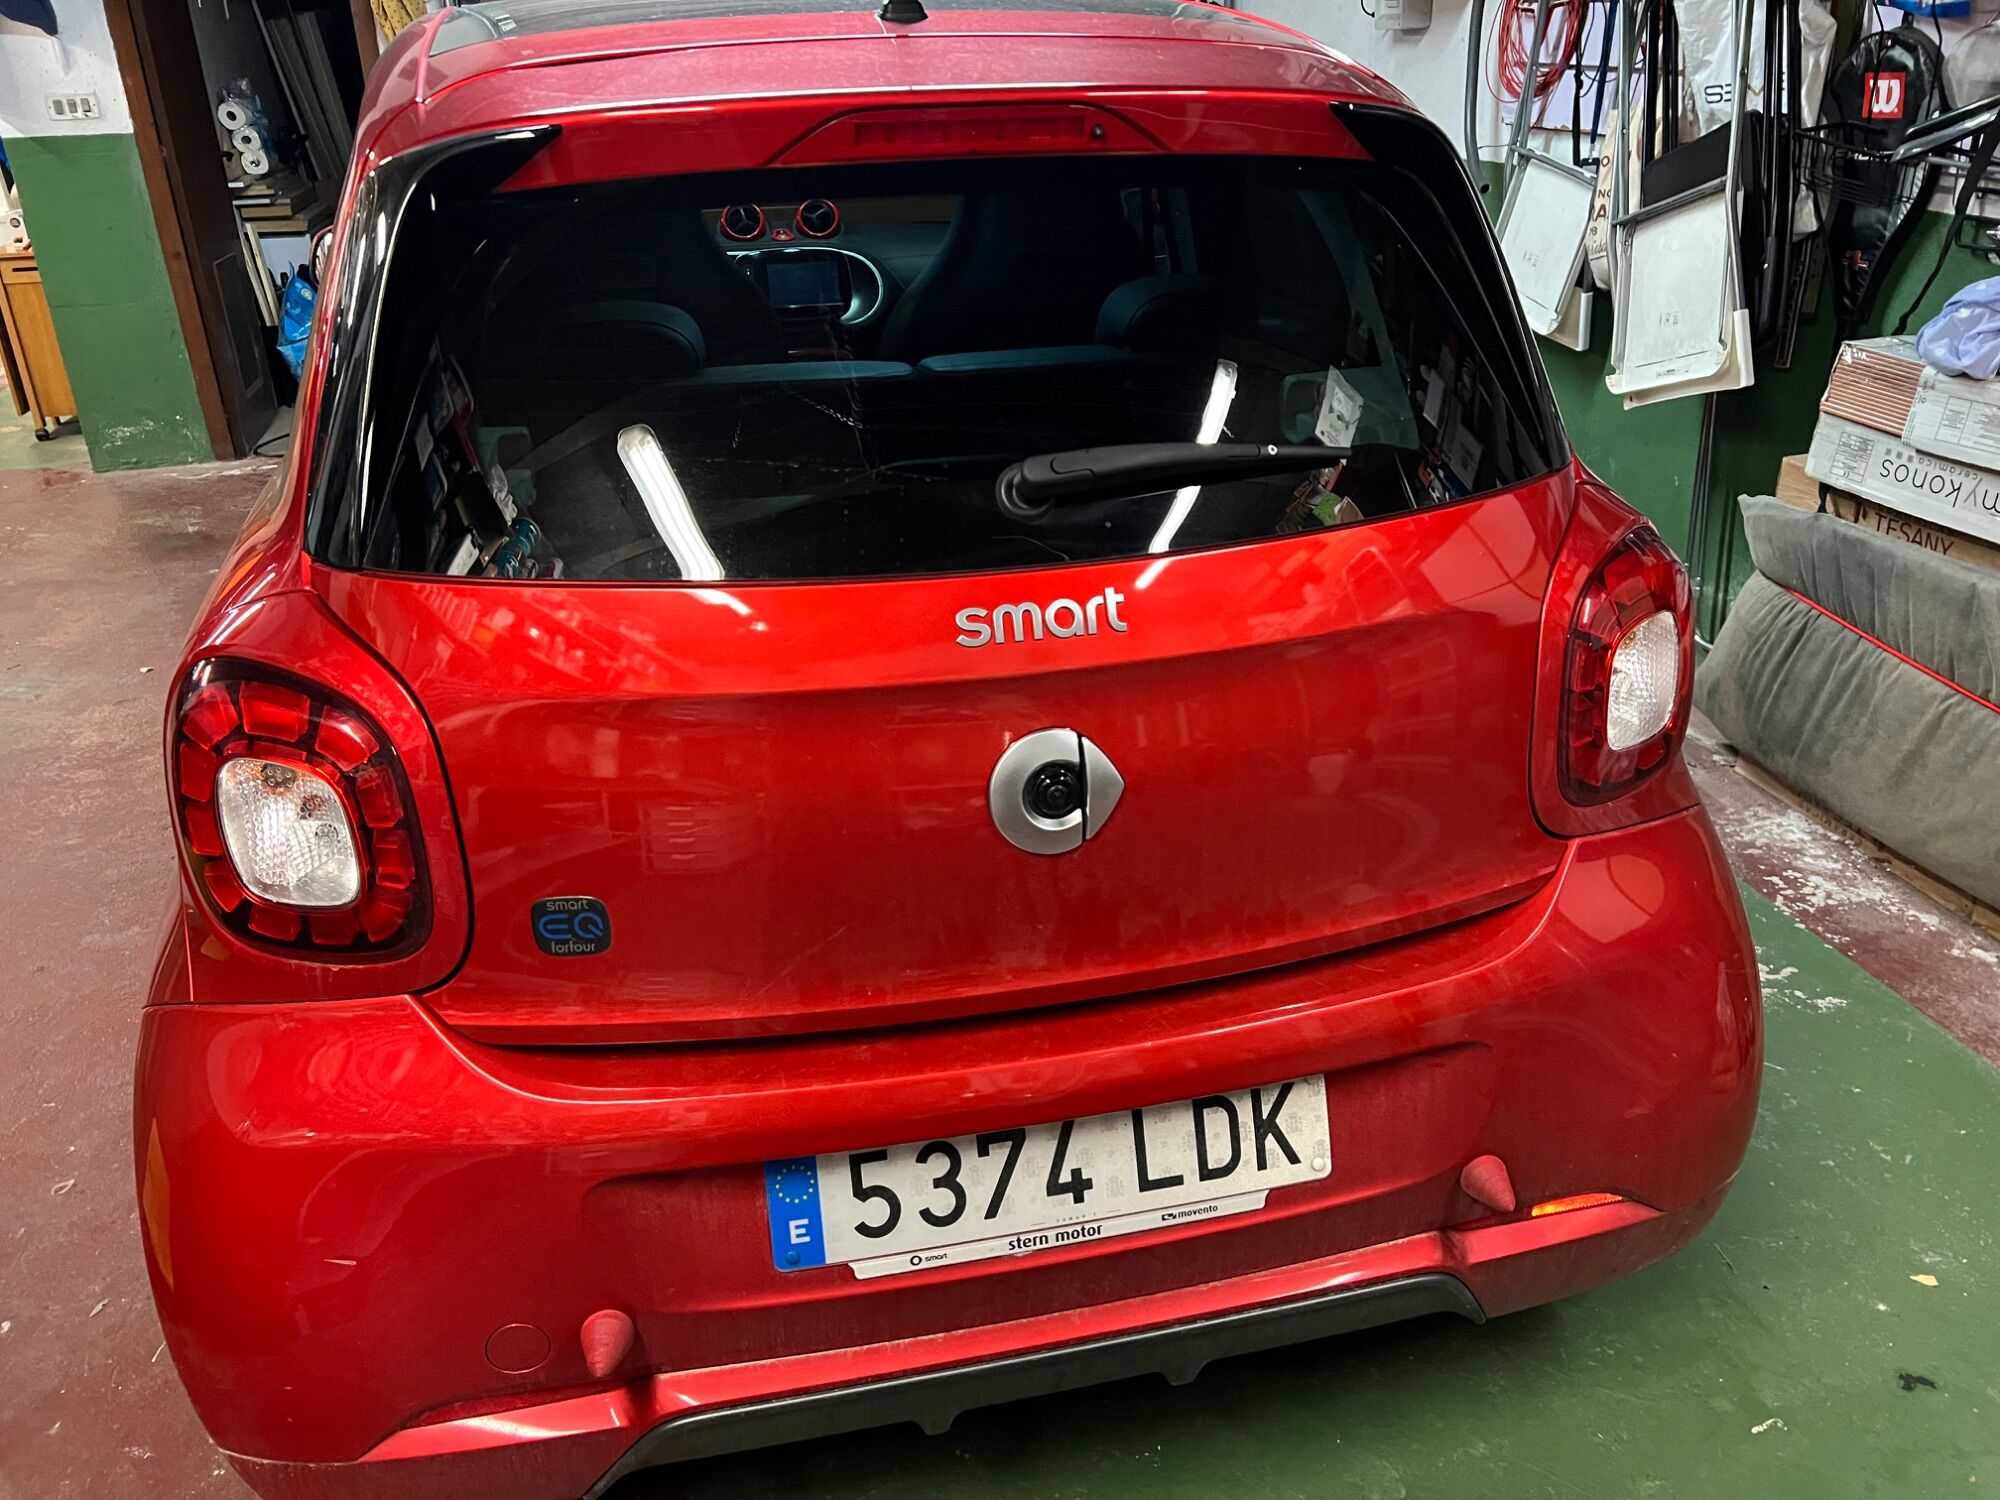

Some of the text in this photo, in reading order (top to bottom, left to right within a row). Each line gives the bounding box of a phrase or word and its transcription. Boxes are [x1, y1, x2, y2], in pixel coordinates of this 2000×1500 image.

[955, 587, 1128, 647] smart
[546, 899, 589, 911] smart
[539, 912, 604, 939] EQ
[551, 939, 596, 953] forfour
[848, 1082, 1302, 1239] 5374 LDK
[1178, 1205, 1218, 1218] movento
[789, 1218, 811, 1245] E
[1008, 1224, 1103, 1251] stern motor
[924, 1253, 948, 1262] smart
